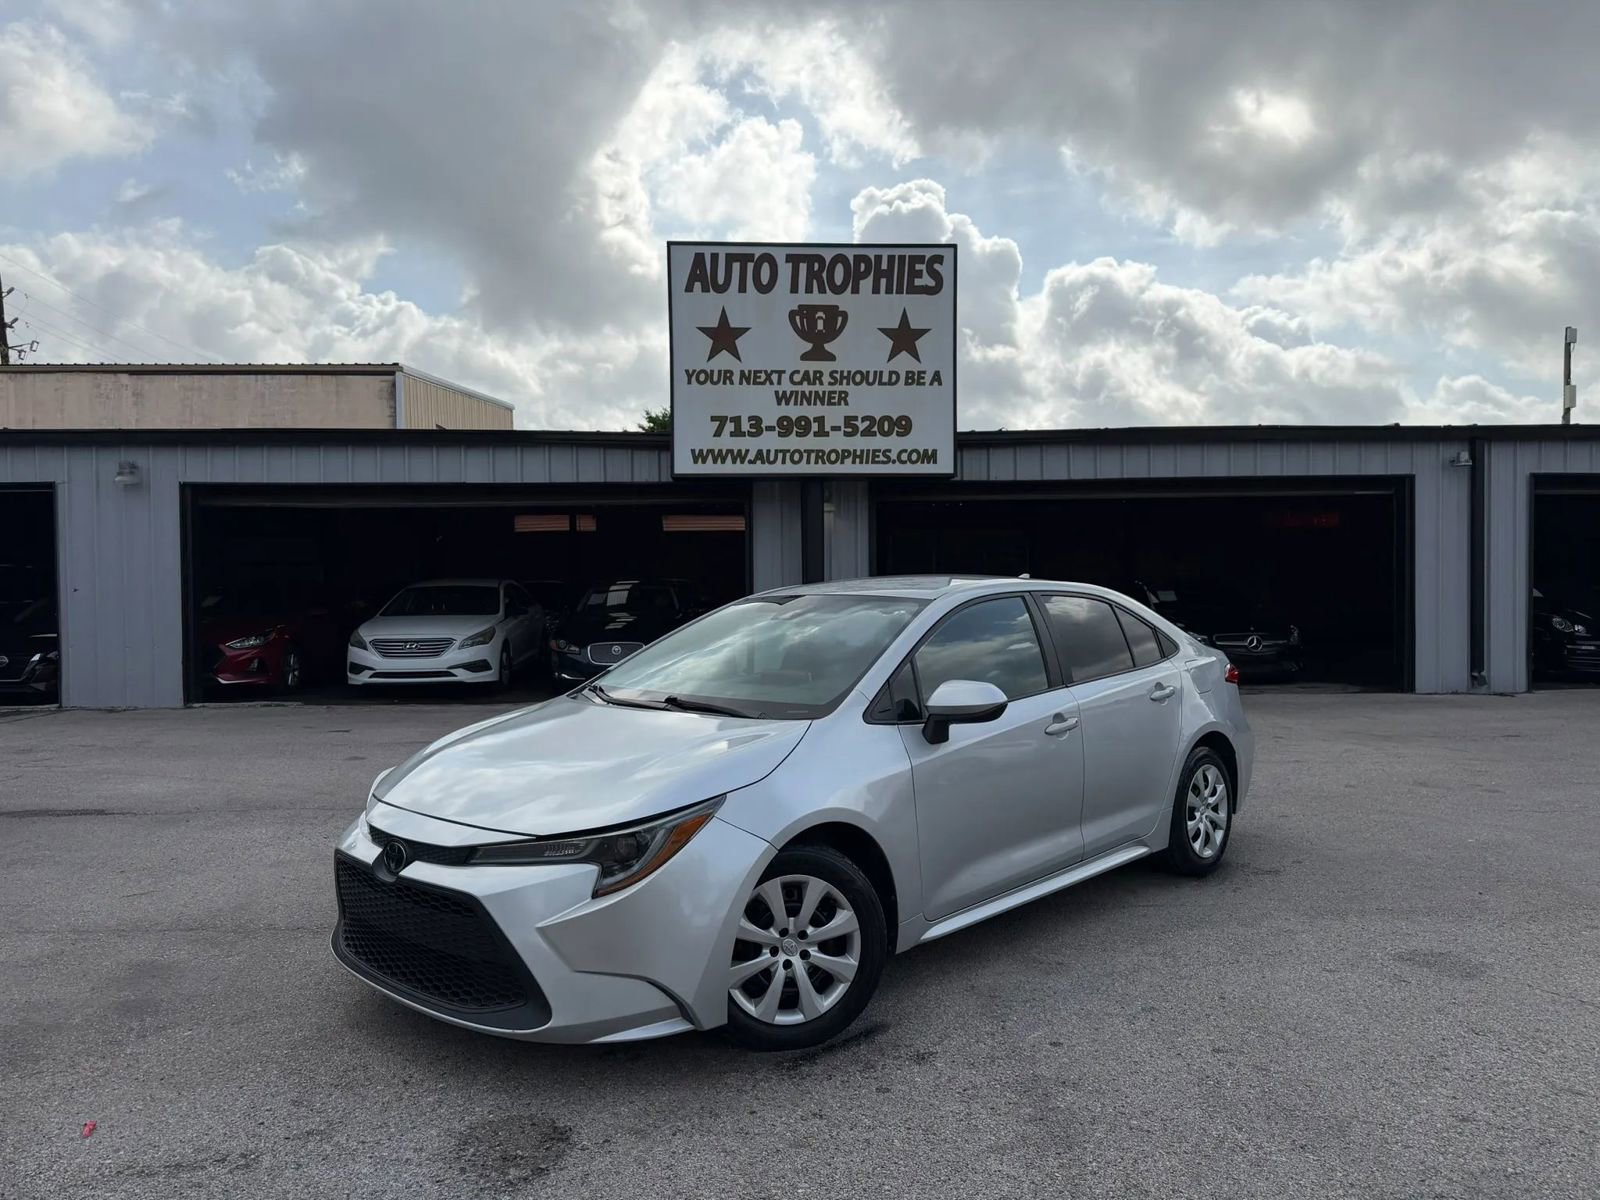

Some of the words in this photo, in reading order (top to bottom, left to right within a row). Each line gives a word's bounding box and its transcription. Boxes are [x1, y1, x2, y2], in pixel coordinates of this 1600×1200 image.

[684, 252, 779, 294] AUTO
[785, 253, 944, 295] TROPHIES
[685, 369, 734, 385] YOUR
[739, 370, 786, 385] NEXT
[789, 370, 824, 386] CAR
[828, 370, 900, 386] SHOULD
[904, 371, 926, 386] BE
[929, 371, 943, 386] A
[774, 391, 849, 406] WINNER
[710, 415, 913, 438] 713-991-5209
[691, 449, 938, 465] WWW.AUTOTROPHIES.COM
